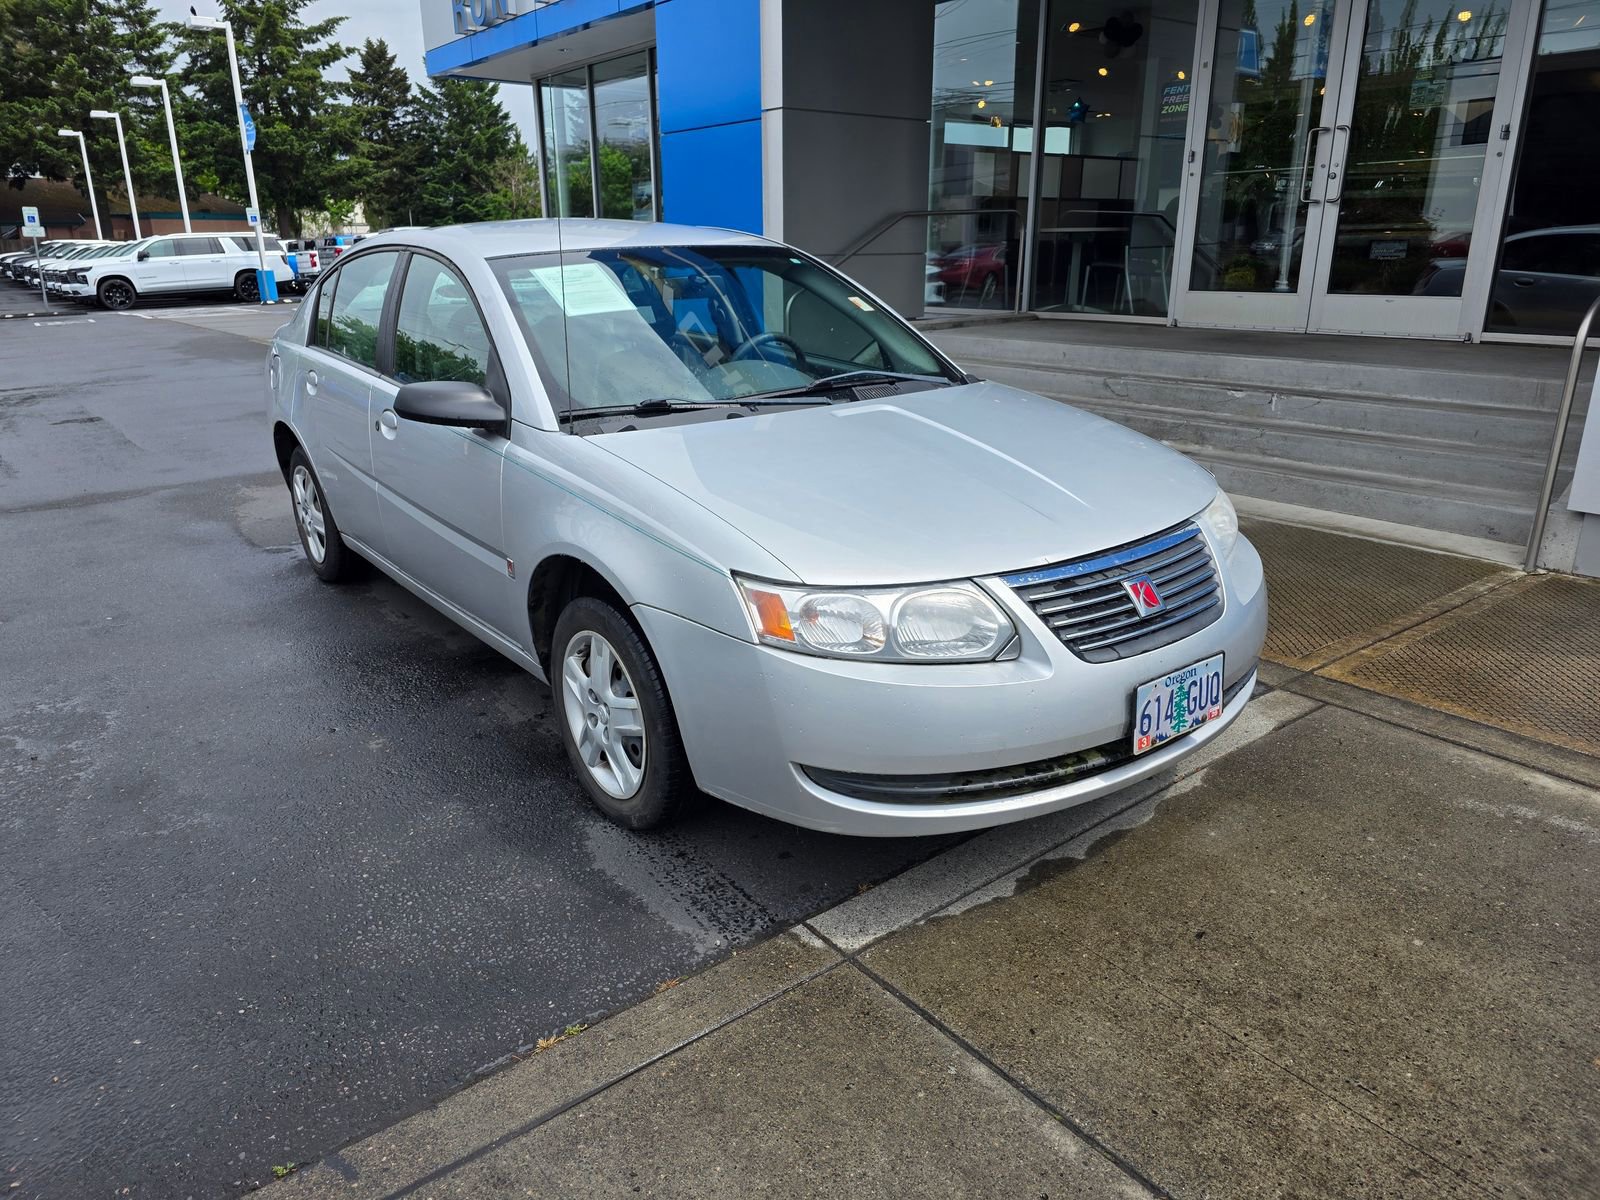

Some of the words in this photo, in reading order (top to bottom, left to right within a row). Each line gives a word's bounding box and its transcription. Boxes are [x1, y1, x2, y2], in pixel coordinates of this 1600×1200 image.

[1164, 85, 1190, 95] FENT
[1162, 95, 1190, 104] FREE
[1161, 104, 1188, 114] ZONE
[1165, 668, 1197, 688] Oregon
[1140, 689, 1174, 736] 614
[1187, 672, 1219, 715] GUQ
